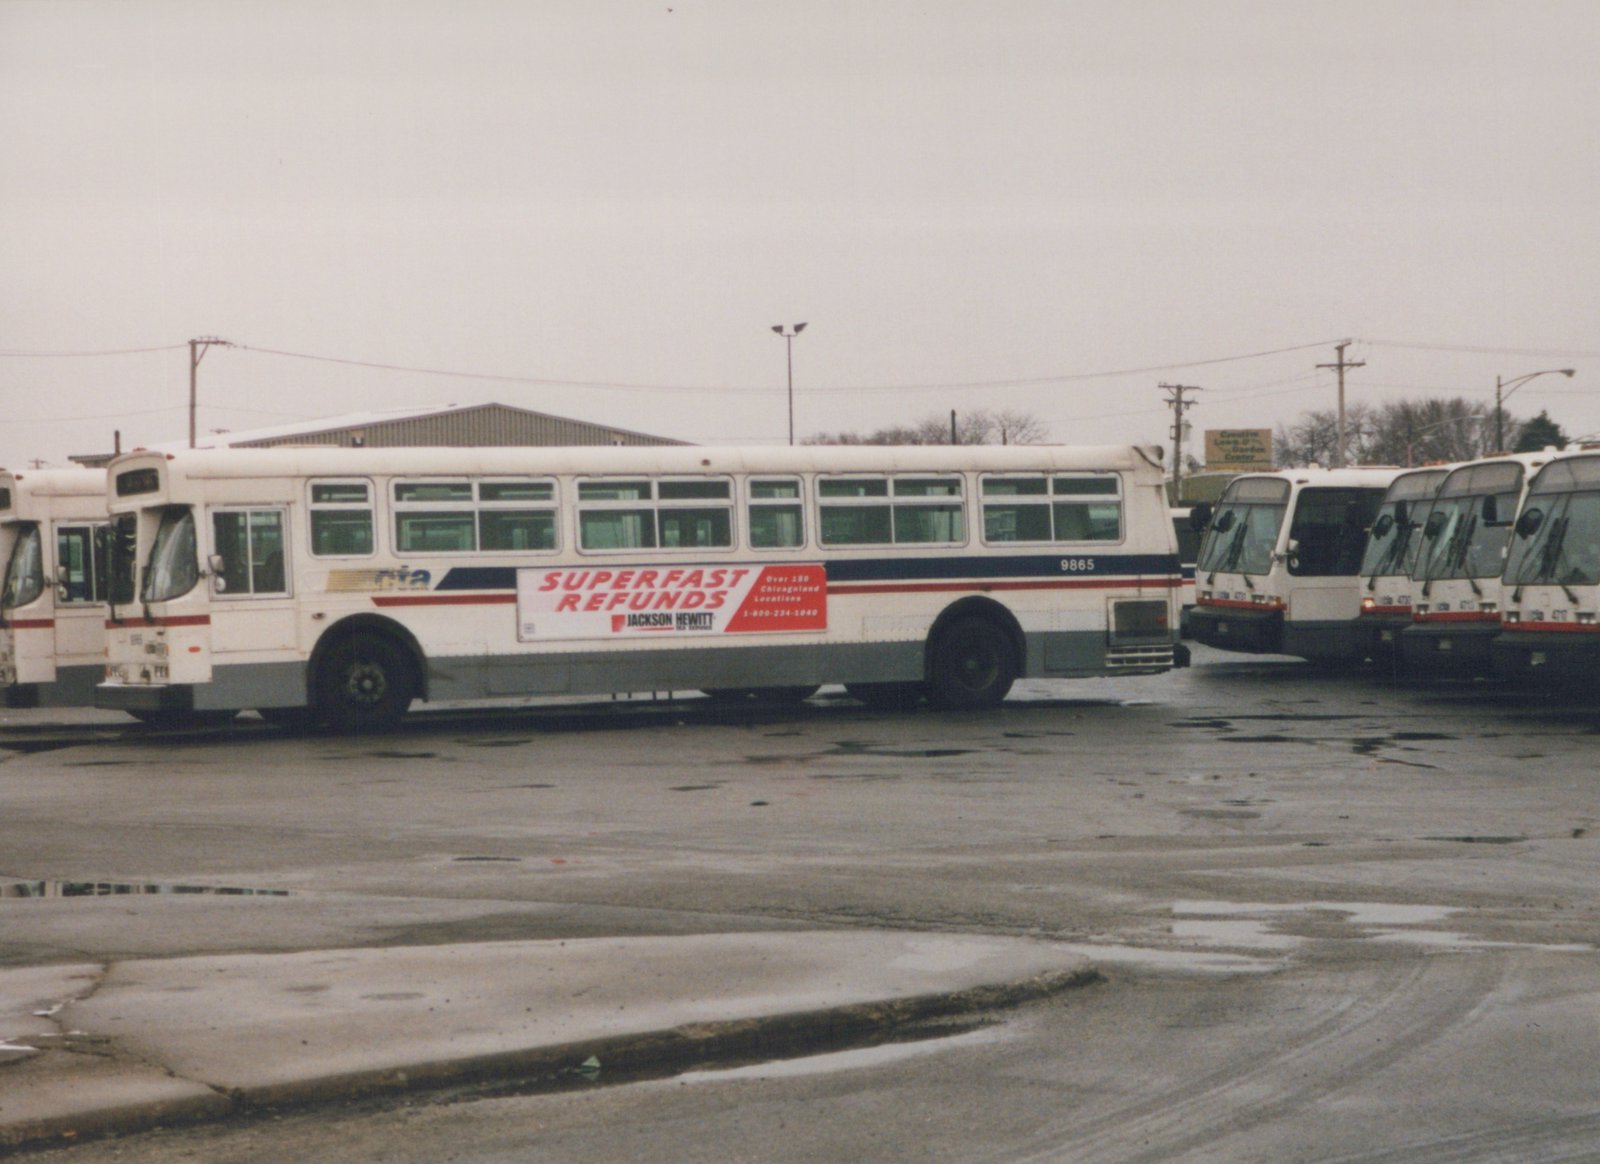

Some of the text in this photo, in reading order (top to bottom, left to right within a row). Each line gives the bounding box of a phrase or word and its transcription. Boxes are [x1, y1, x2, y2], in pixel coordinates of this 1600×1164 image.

[1060, 559, 1095, 571] 9865
[538, 568, 750, 592] SUPERFAST
[554, 590, 729, 612] REFUNDS
[754, 595, 801, 603] Locations
[627, 612, 713, 627] JACKSON HEWITT
